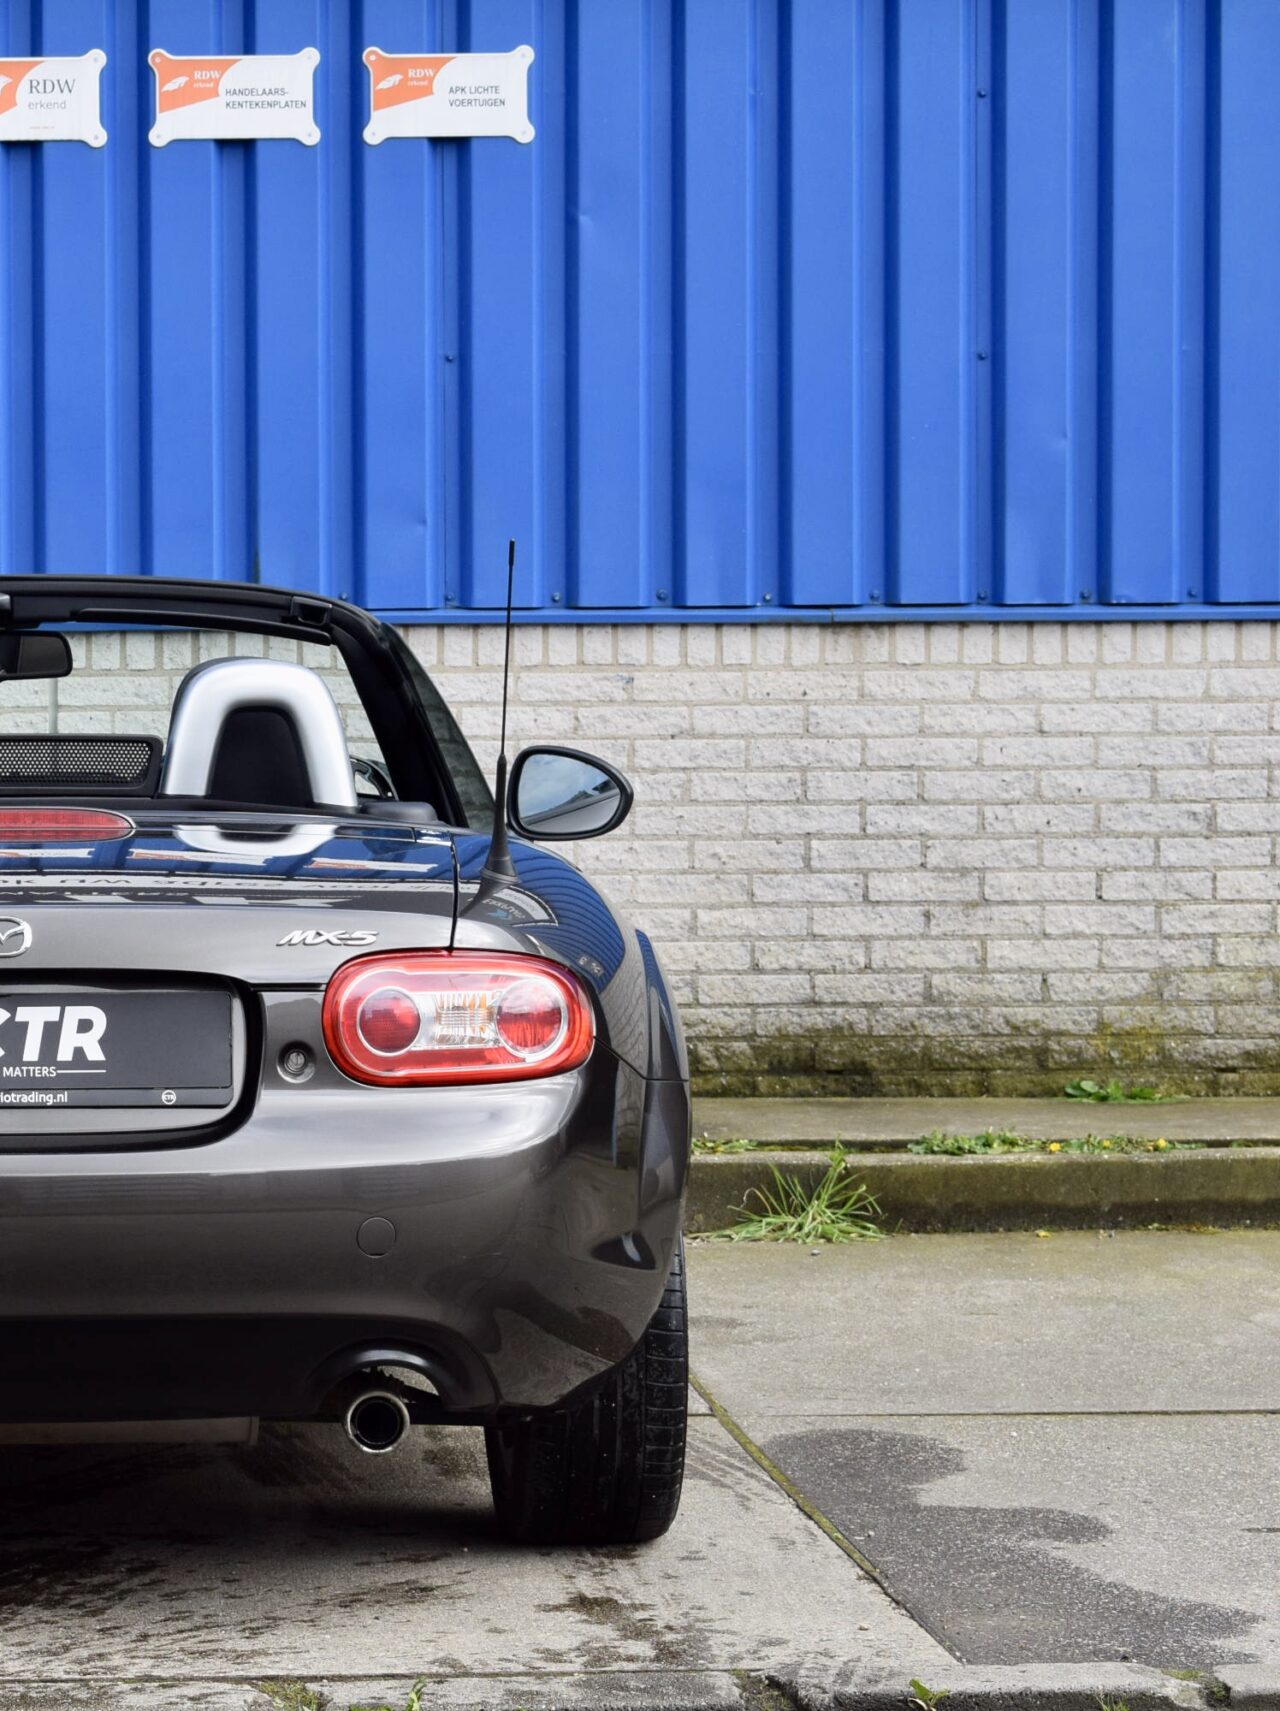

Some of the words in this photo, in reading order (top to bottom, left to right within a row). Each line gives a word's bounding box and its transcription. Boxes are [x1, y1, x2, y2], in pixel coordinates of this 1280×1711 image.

[193, 70, 222, 80] RDW
[407, 68, 436, 78] RDW
[28, 78, 77, 94] RDW
[448, 86, 468, 94] APK
[469, 85, 500, 94] LICHTE
[225, 88, 289, 96] HANDELAARS-
[27, 100, 67, 110] erkend
[225, 100, 307, 109] KENTEKENPLATEN
[448, 98, 506, 107] VOERTUIGEN
[2, 1065, 57, 1078] MATTERS
